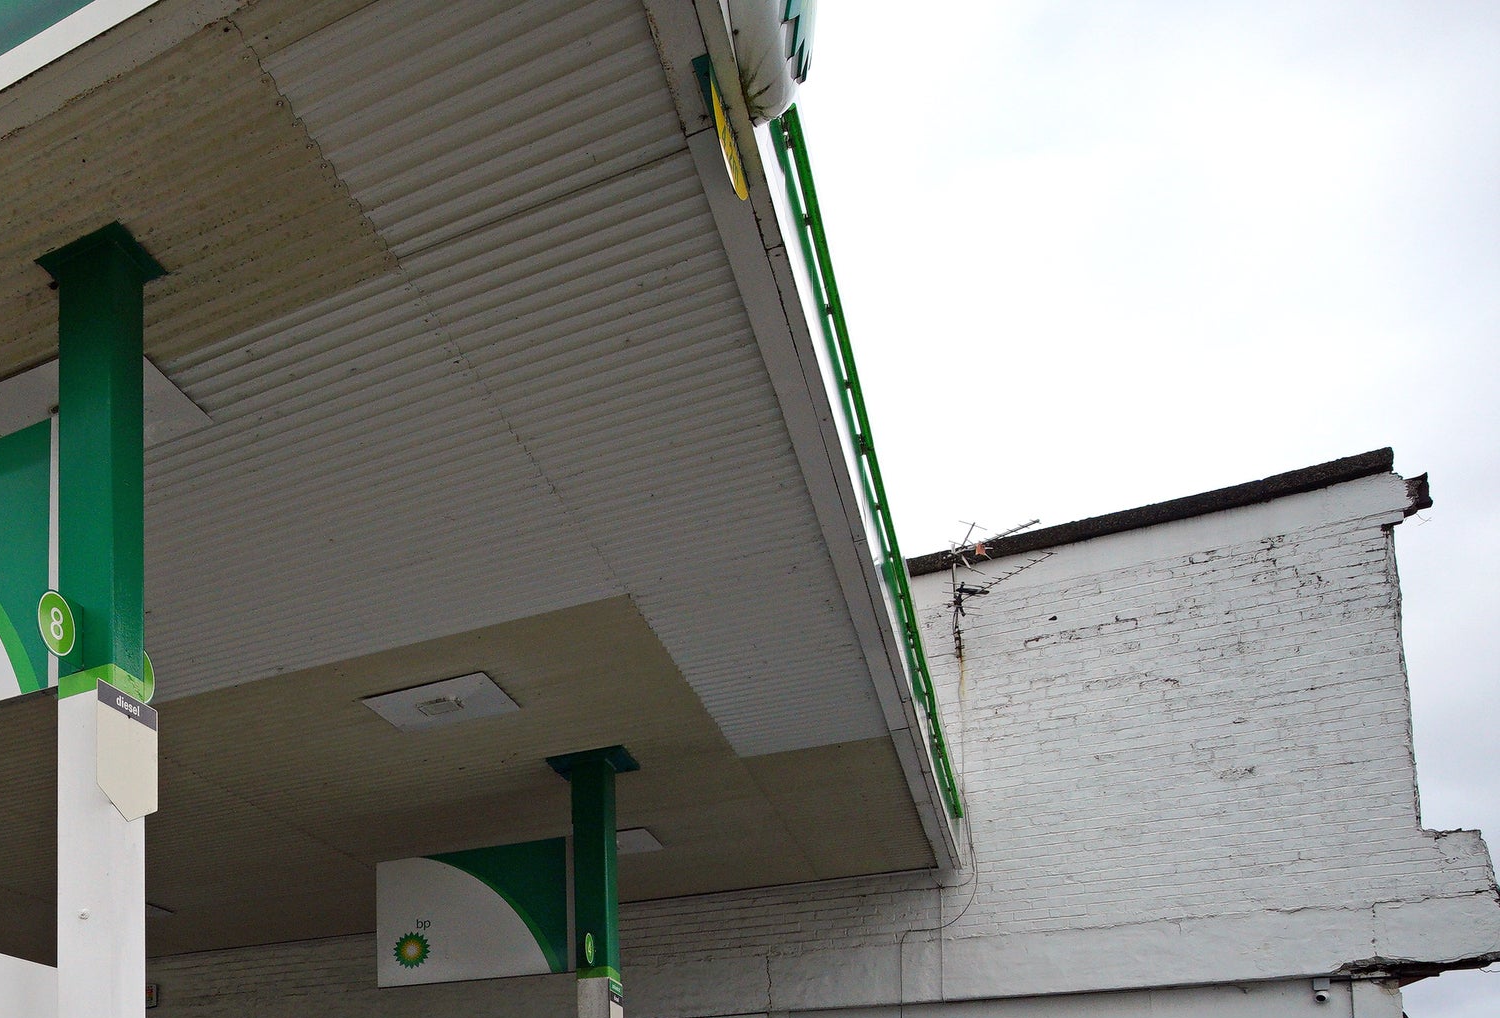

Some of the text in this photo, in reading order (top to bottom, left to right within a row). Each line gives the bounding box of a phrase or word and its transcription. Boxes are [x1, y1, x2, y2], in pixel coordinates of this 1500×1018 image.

[50, 607, 64, 640] 8
[116, 696, 140, 717] diesel
[416, 918, 431, 931] bp
